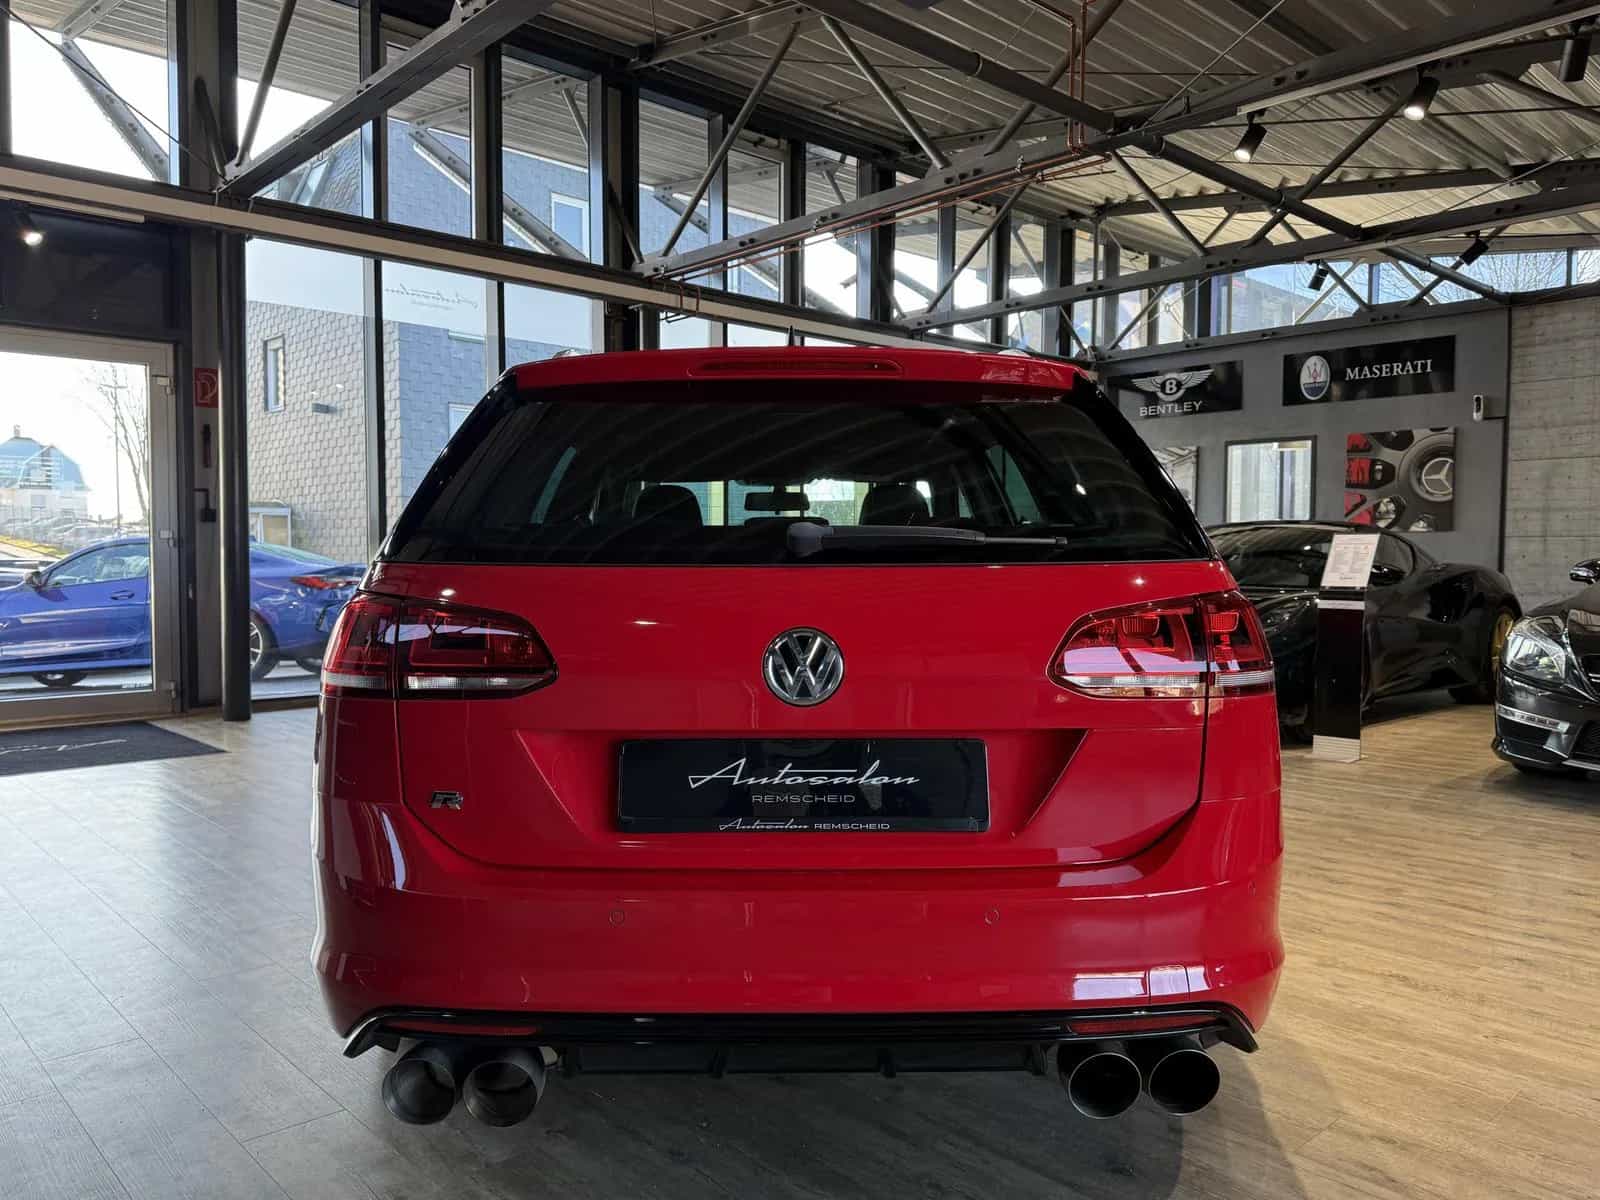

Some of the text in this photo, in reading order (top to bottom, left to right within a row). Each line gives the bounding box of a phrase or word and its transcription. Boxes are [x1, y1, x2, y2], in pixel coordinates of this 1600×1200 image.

[1344, 359, 1433, 381] MASERATI
[1164, 379, 1178, 394] B
[1139, 400, 1203, 417] BENTLEY
[688, 757, 921, 789] Autosalon
[751, 794, 857, 804] REMSCHEID
[719, 817, 891, 832] Autosalon REMSCHEID
